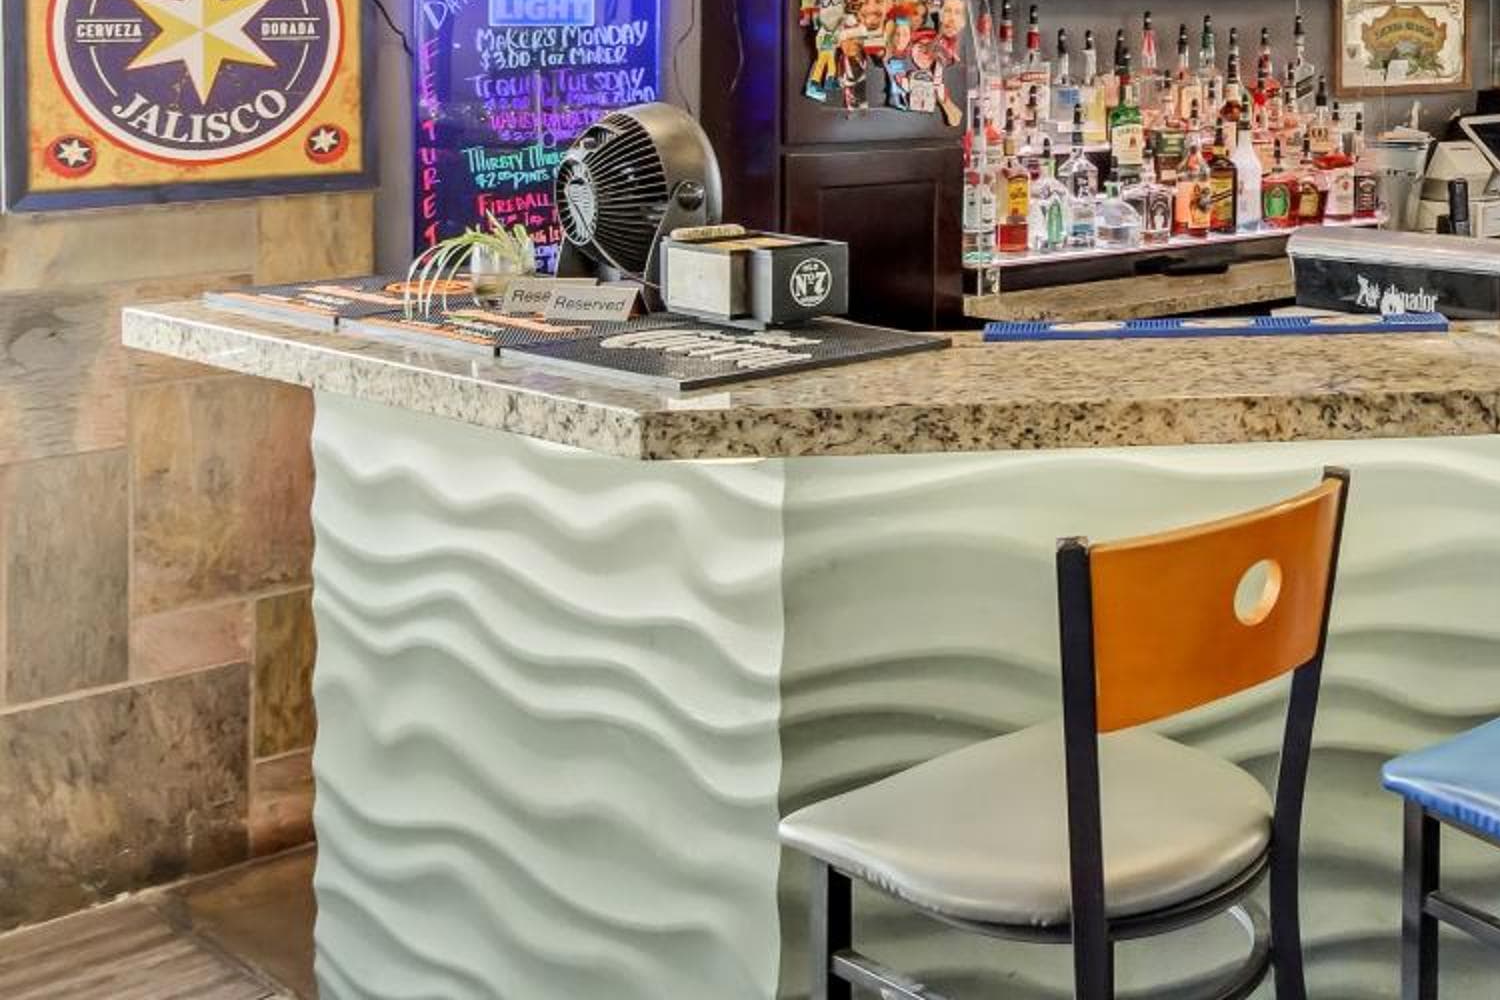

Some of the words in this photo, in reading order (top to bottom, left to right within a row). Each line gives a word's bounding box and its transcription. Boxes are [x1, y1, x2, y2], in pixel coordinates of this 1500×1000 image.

[76, 23, 143, 38] CERVEZA
[261, 21, 316, 37] DORADA
[561, 20, 648, 50] MONDAY
[112, 89, 287, 143] JALISCO
[511, 289, 552, 304] Rese
[553, 295, 625, 313] Reserved
